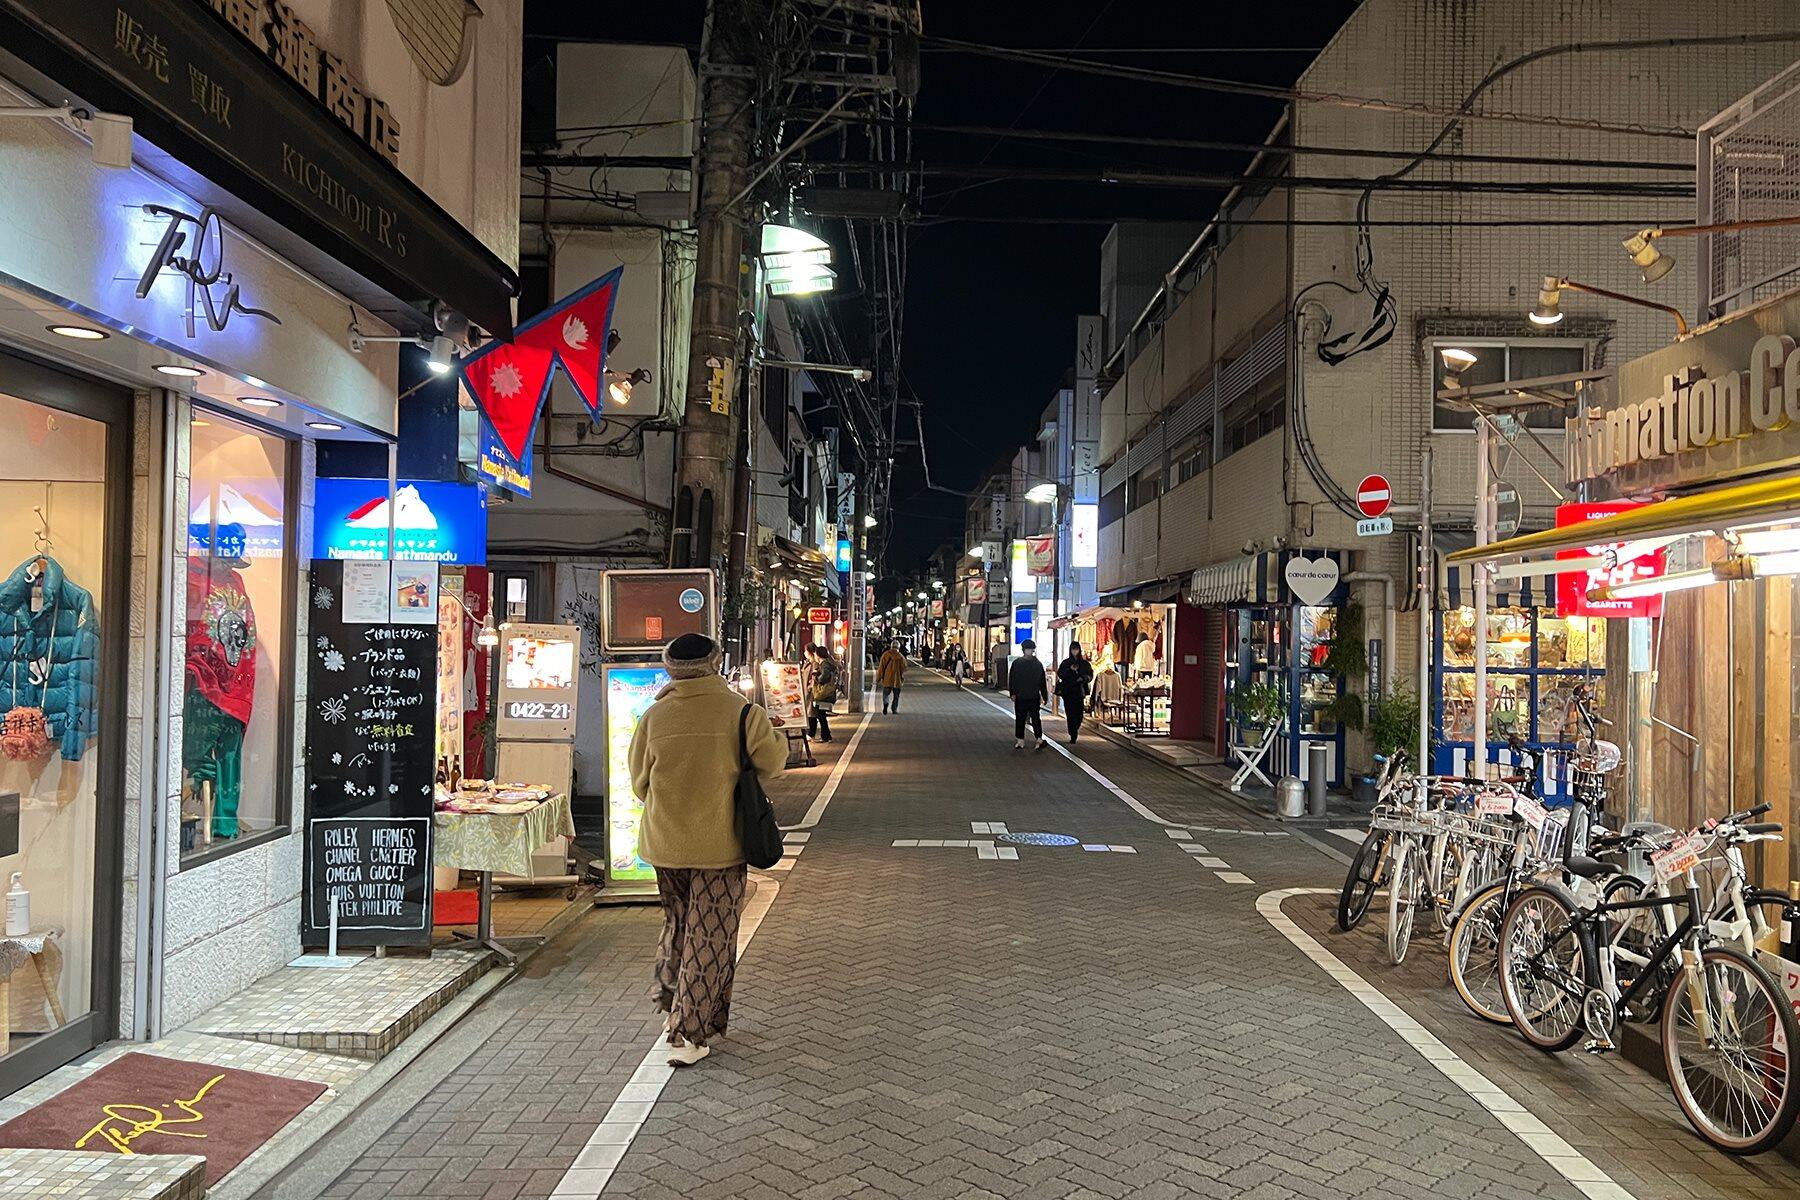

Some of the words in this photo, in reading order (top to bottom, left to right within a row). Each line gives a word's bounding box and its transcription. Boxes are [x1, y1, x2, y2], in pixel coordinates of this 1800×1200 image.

[115, 8, 169, 83] 販売
[188, 62, 231, 128] 買取
[394, 549, 458, 562] athmandu
[360, 648, 405, 662] ブランド品
[324, 827, 358, 847] ROLEX
[372, 828, 416, 848] HERMES
[325, 848, 362, 865] CHANEL
[370, 848, 417, 866] CARTIER
[326, 866, 361, 883] OMEGA
[370, 866, 405, 882] GUCCI
[359, 883, 405, 900] VUITTON
[362, 899, 403, 916] PHILIPPE
